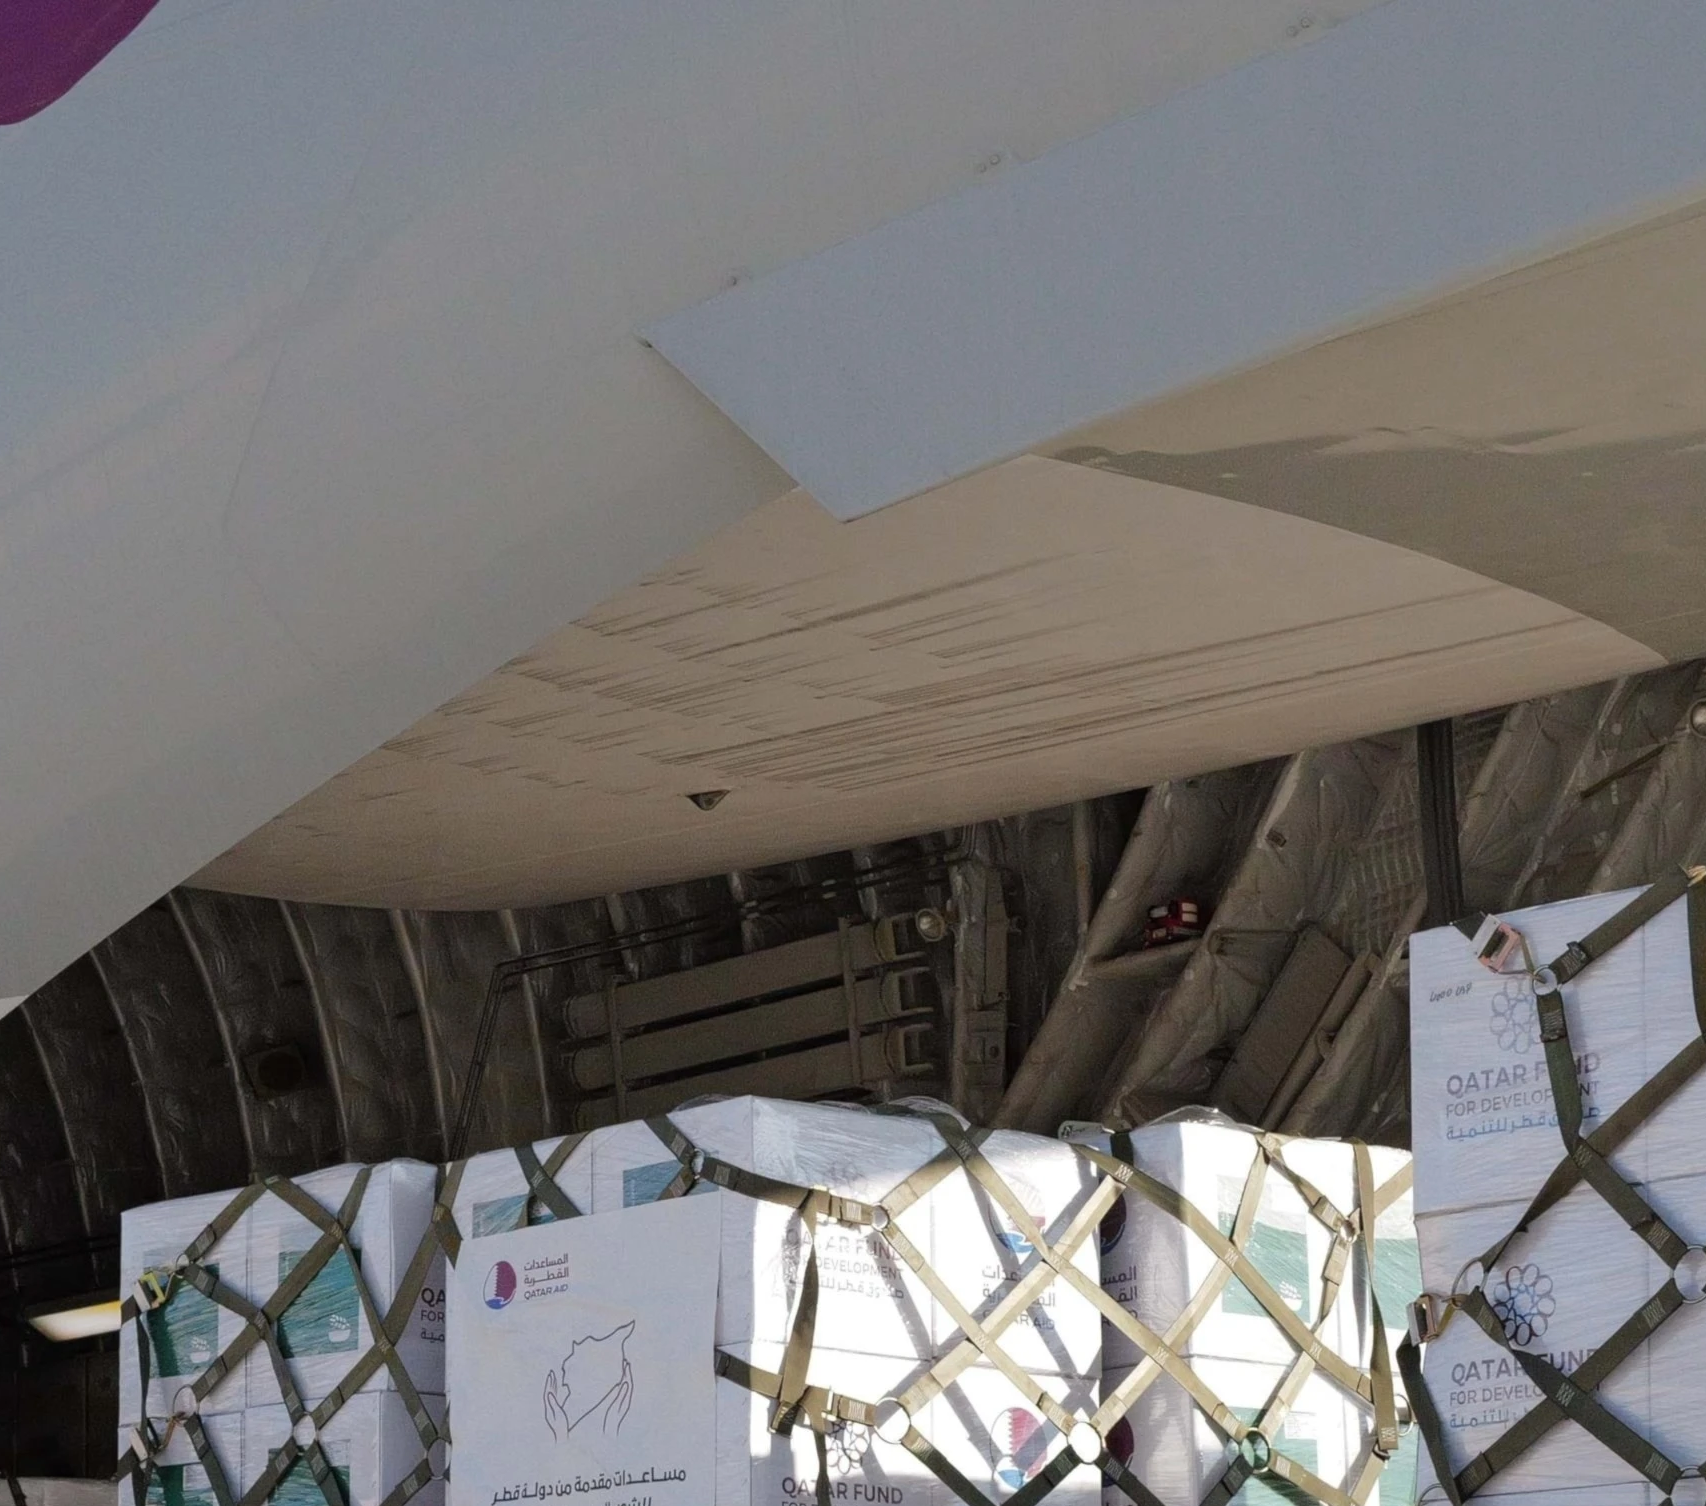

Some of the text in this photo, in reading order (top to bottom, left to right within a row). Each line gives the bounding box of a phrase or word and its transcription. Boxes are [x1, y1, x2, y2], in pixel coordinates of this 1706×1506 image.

[1446, 1064, 1527, 1099] QATAR
[1446, 1080, 1600, 1118] FOR DEVELOPNT
[1446, 1117, 1508, 1142] للتنمية
[524, 1284, 568, 1300] QATAR AID
[1450, 1390, 1477, 1406] FOR
[491, 1466, 686, 1506] مساعدات مقدمة من دولة قطر
[854, 1483, 903, 1504] FUND
